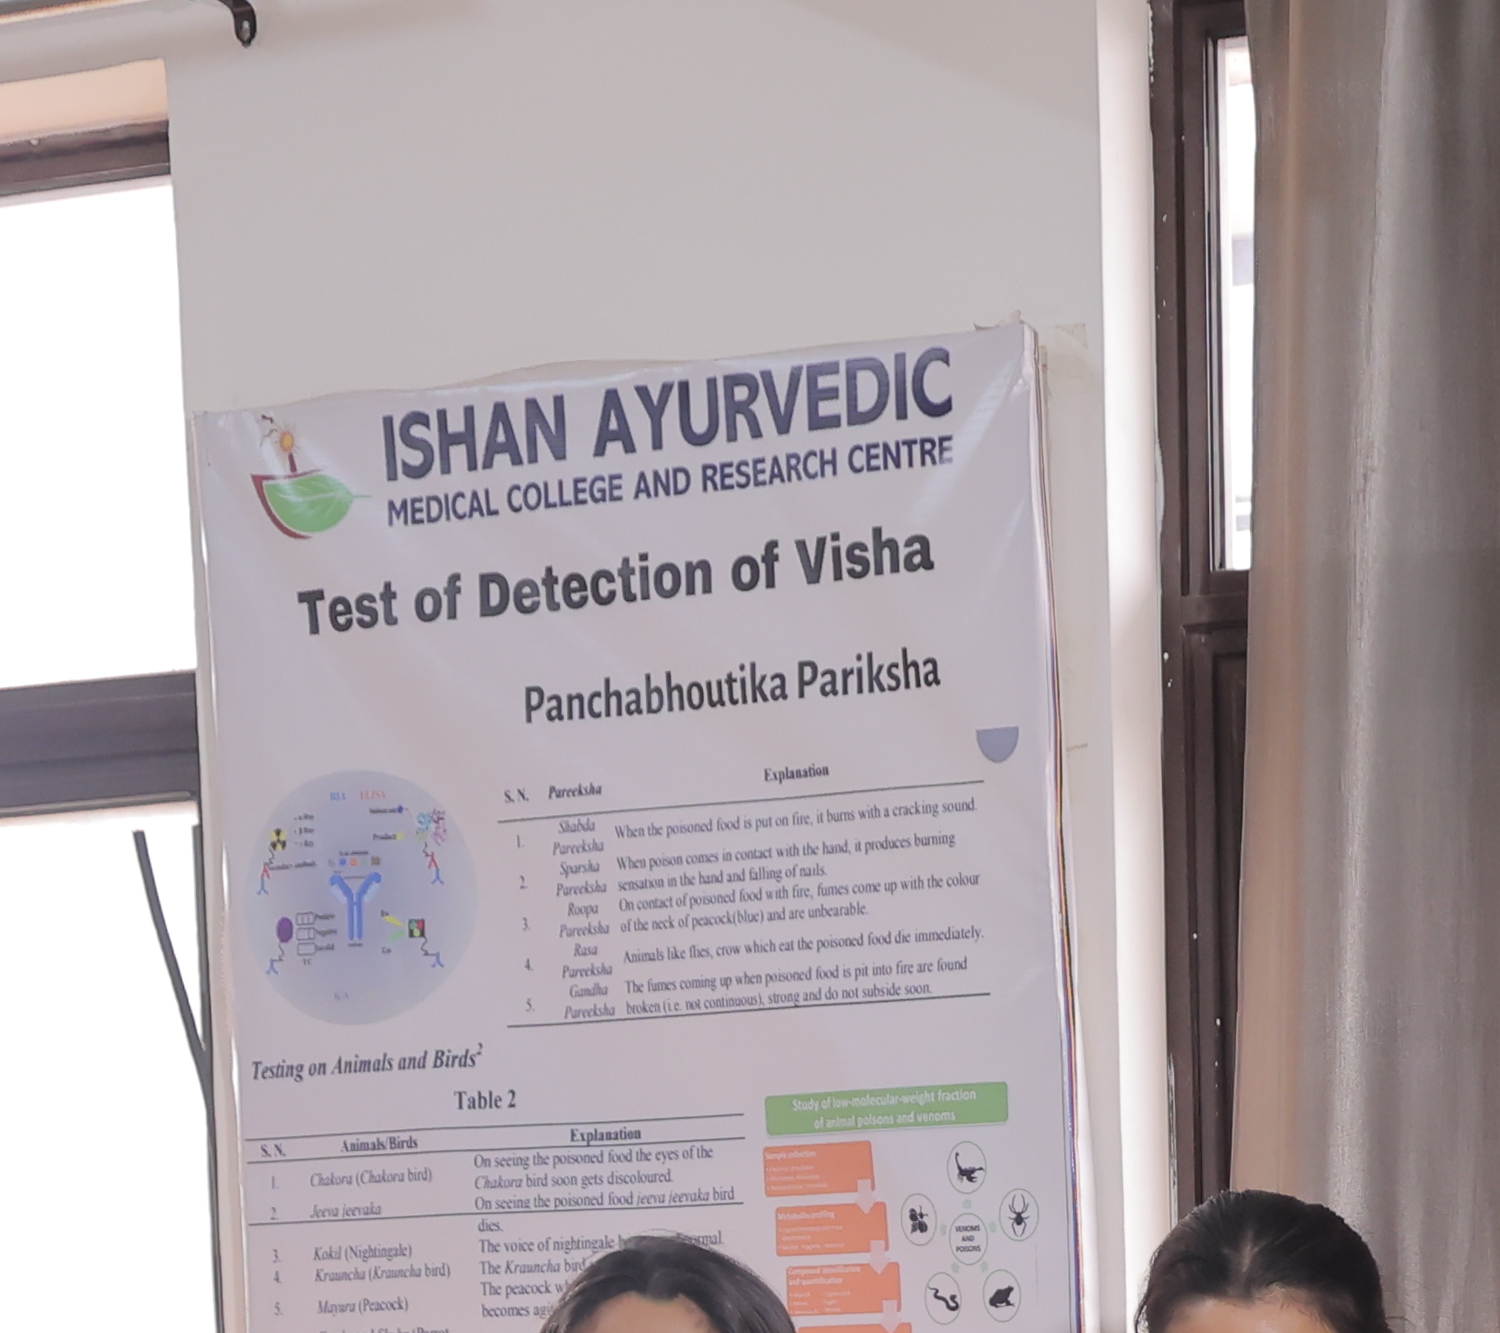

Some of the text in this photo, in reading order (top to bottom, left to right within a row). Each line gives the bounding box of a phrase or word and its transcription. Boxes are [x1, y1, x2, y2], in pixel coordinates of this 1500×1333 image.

[382, 346, 953, 482] ISHAN AYURVEDIC
[386, 435, 954, 527] MEDICAL COLLEGE AND RESEARCH CENTRE
[296, 527, 934, 635] Test of Detection of Visha
[523, 648, 941, 724] Panchabhoutika Pariksha
[763, 763, 830, 784] Explanation
[547, 782, 603, 800] Pareeksha
[614, 796, 978, 839] When the poisoned food is put on fire, it burns with a cracking sound.
[616, 831, 955, 873] When poison comes in contact with the hand, it produces burning
[623, 924, 984, 964] Animals like flies, crow which eat the poisoned food die immediately.
[251, 1059, 303, 1085] Testing
[308, 1063, 326, 1078] on
[331, 1054, 393, 1076] Animals
[397, 1052, 427, 1073] and
[454, 1089, 517, 1111] Table 2
[792, 1088, 977, 1114] Study of low-molecular-weight fraction
[813, 1110, 956, 1130] of animal poisons and venoms
[340, 1135, 418, 1153] Animals/Birds
[569, 1126, 642, 1147] Explanation
[473, 1143, 714, 1173] On seeing the poisoned food the eyes of the
[309, 1167, 432, 1188] Chakora (Chakora bird)
